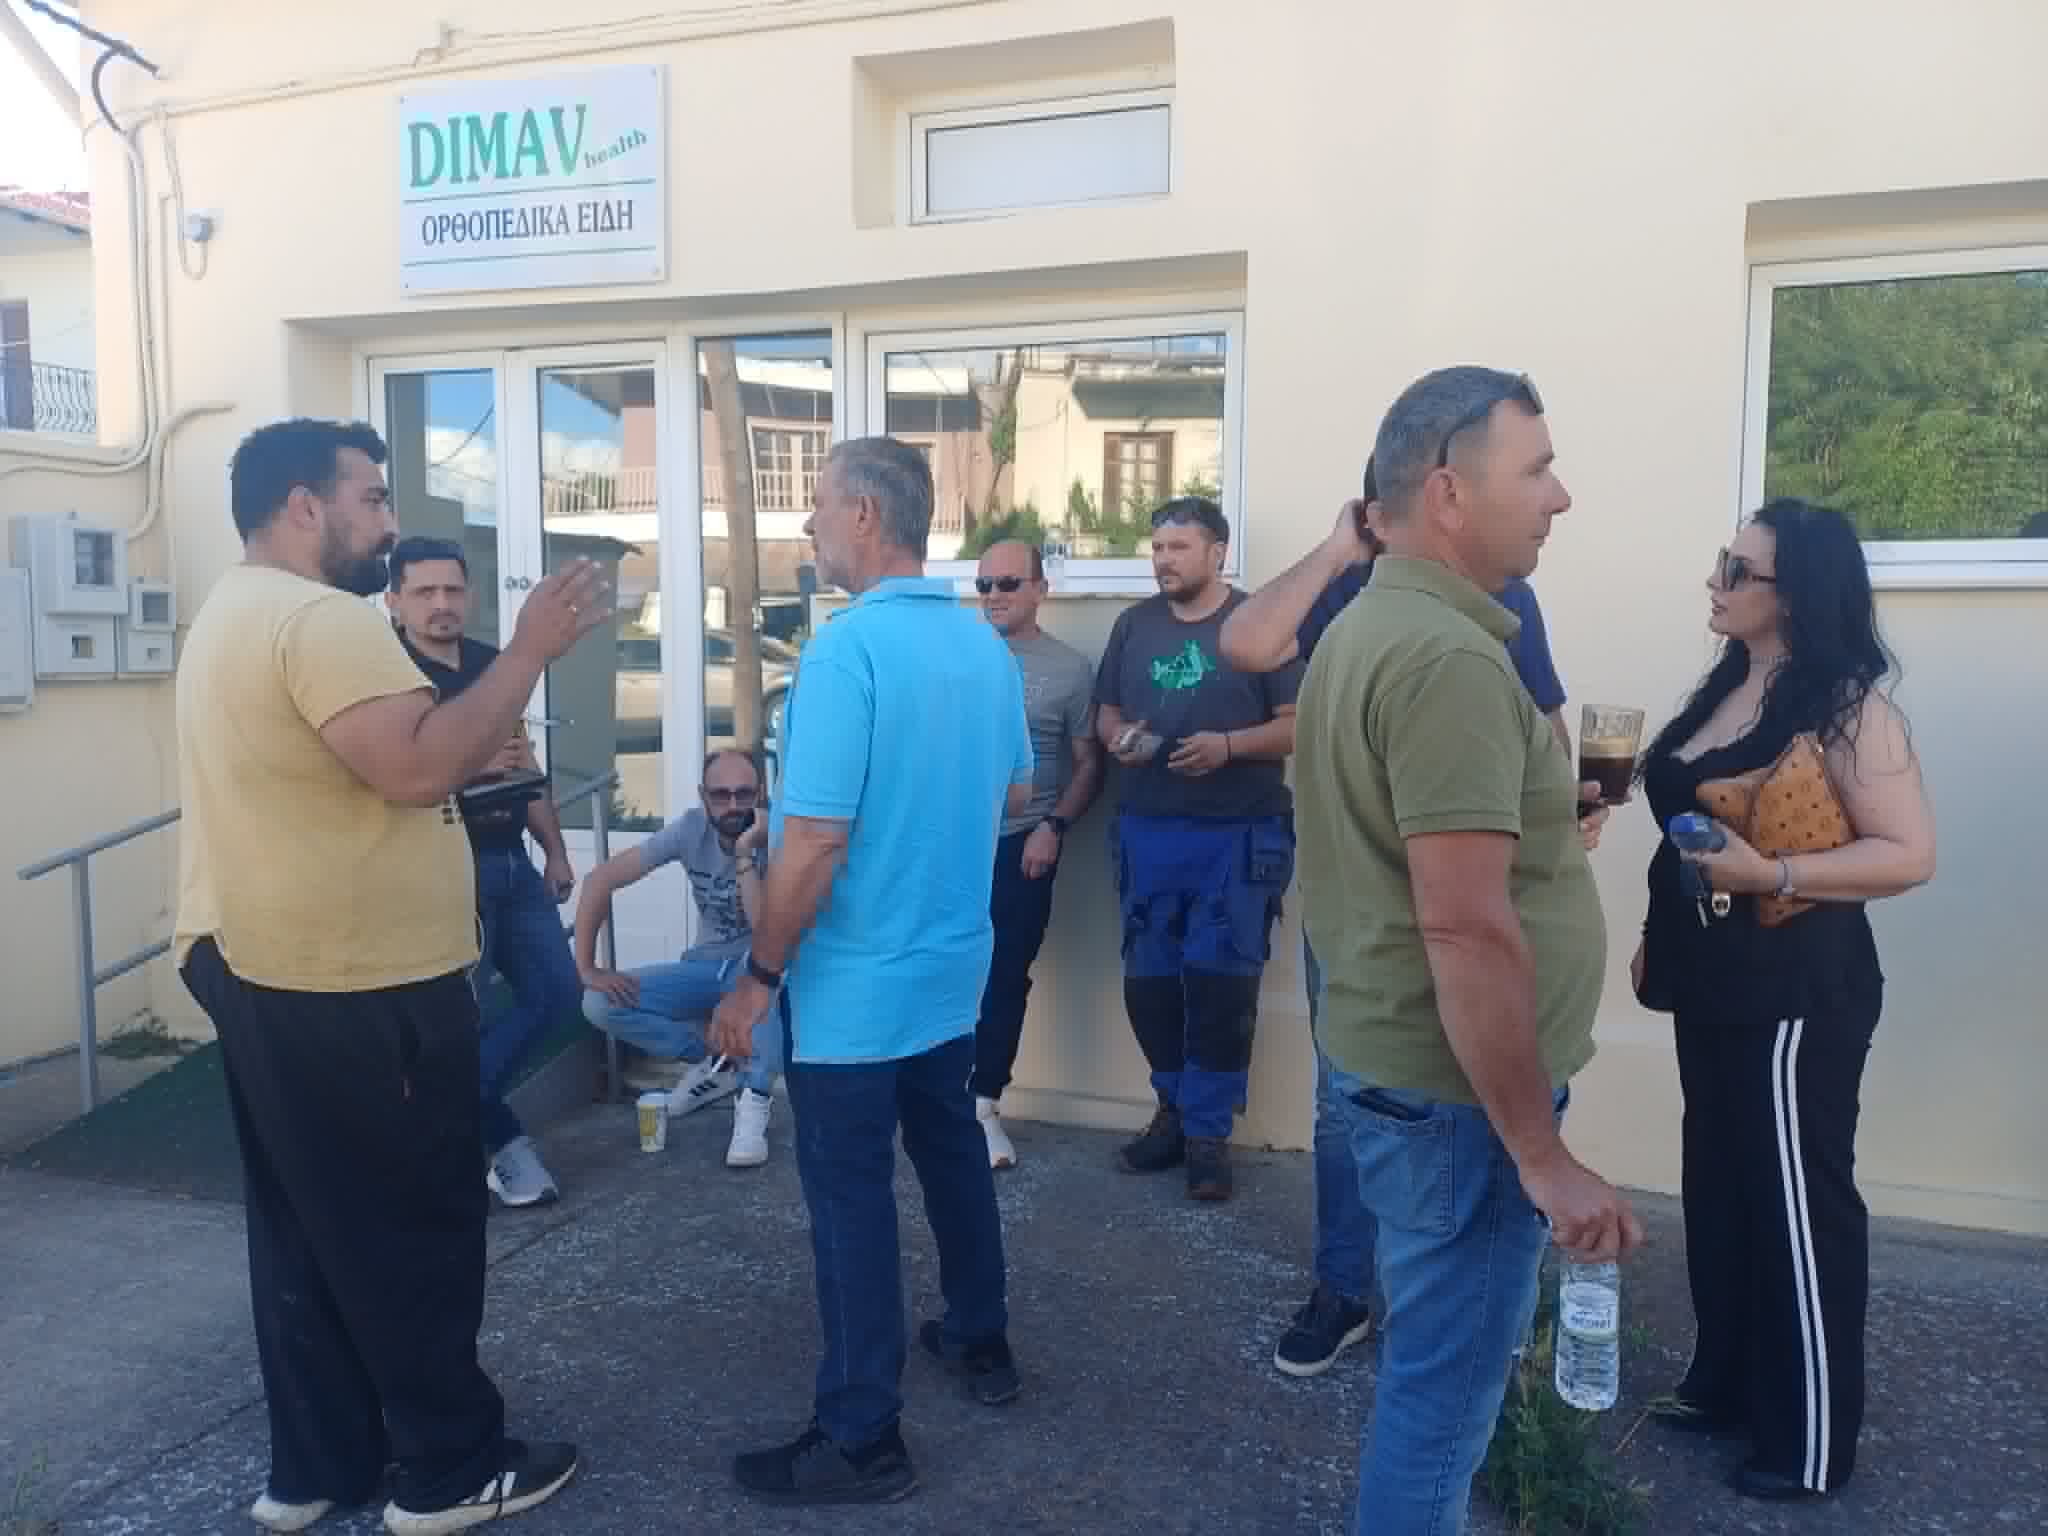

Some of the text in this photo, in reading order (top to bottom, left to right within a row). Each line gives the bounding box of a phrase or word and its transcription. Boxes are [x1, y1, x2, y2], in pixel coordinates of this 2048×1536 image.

[408, 104, 648, 187] DIMAV health
[421, 199, 634, 245] ΟΡΘΟΠΕΔΙΚΑ ΕΙΔΗ
